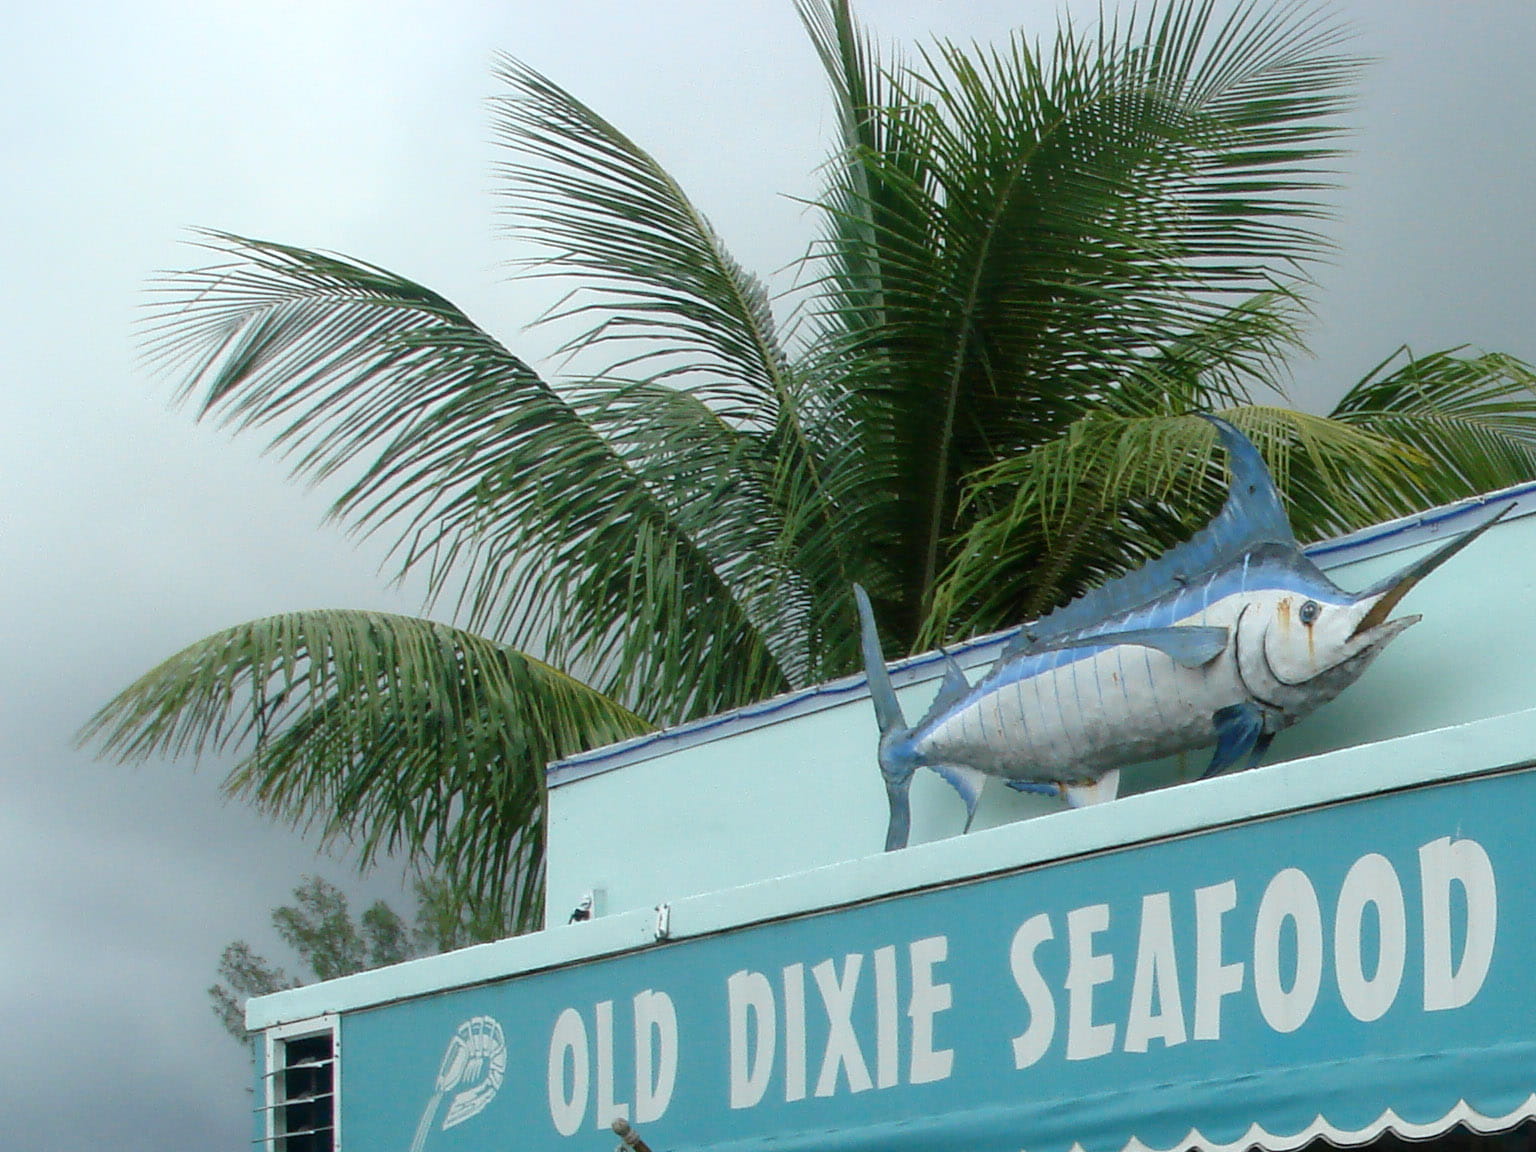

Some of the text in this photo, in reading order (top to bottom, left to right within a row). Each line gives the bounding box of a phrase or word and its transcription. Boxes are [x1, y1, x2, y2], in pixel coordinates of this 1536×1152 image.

[547, 835, 1498, 1137] OLD DIXIE SEAFOOD
